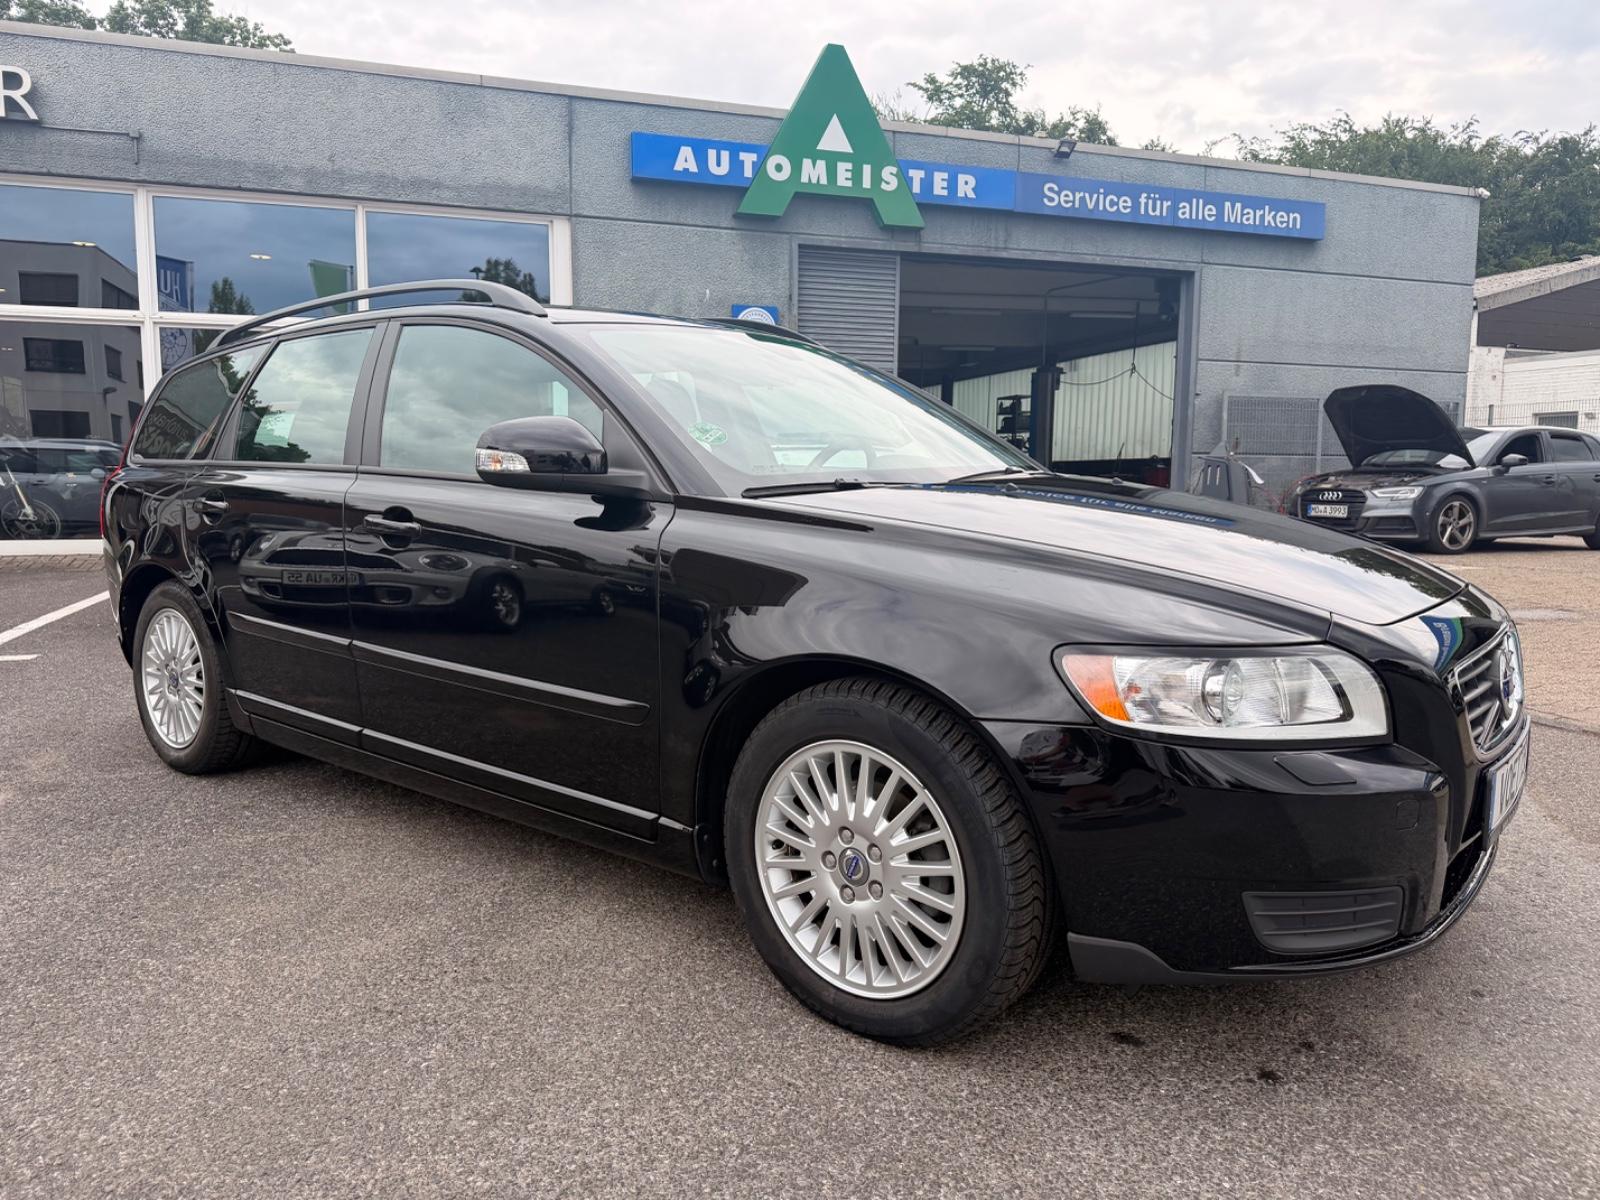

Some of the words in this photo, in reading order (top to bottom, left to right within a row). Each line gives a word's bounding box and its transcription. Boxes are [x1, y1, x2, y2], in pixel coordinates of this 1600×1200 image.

[0, 65, 39, 120] R
[673, 145, 977, 199] AUTOMEISTER
[1042, 183, 1132, 214] Service
[1139, 193, 1172, 217] für
[1177, 198, 1217, 221] alle
[1223, 201, 1301, 230] Marken
